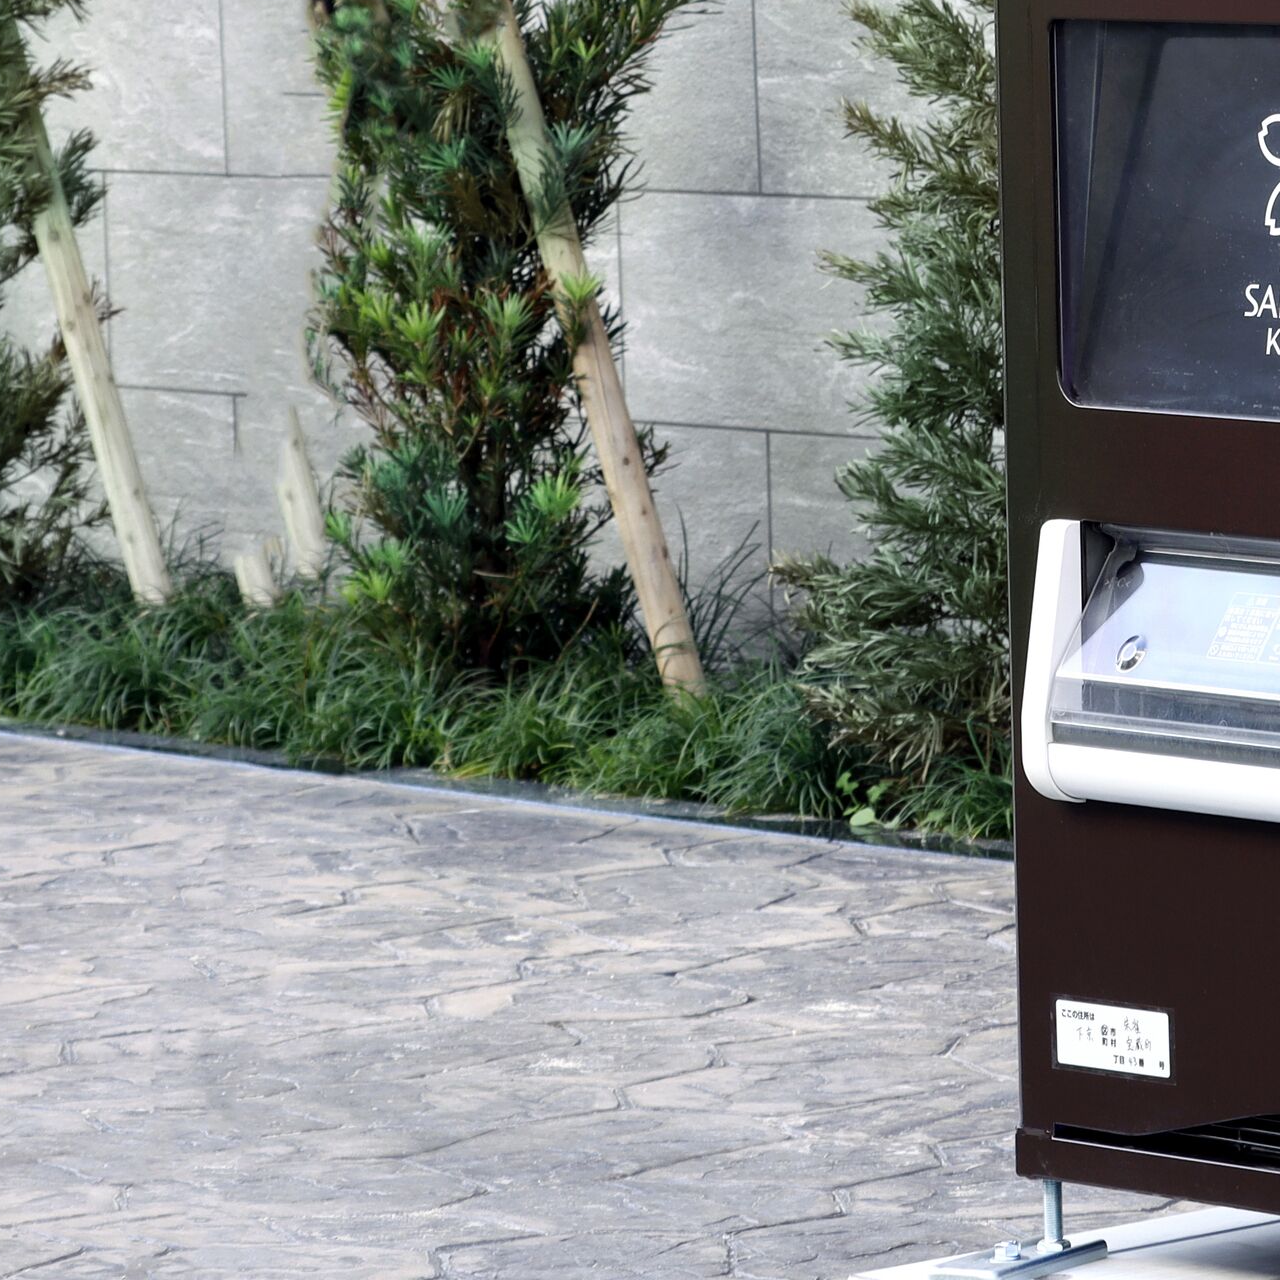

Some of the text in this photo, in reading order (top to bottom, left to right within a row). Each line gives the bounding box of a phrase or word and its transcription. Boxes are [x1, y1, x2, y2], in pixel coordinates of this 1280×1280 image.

[1061, 1009, 1095, 1021] ここの住所は
